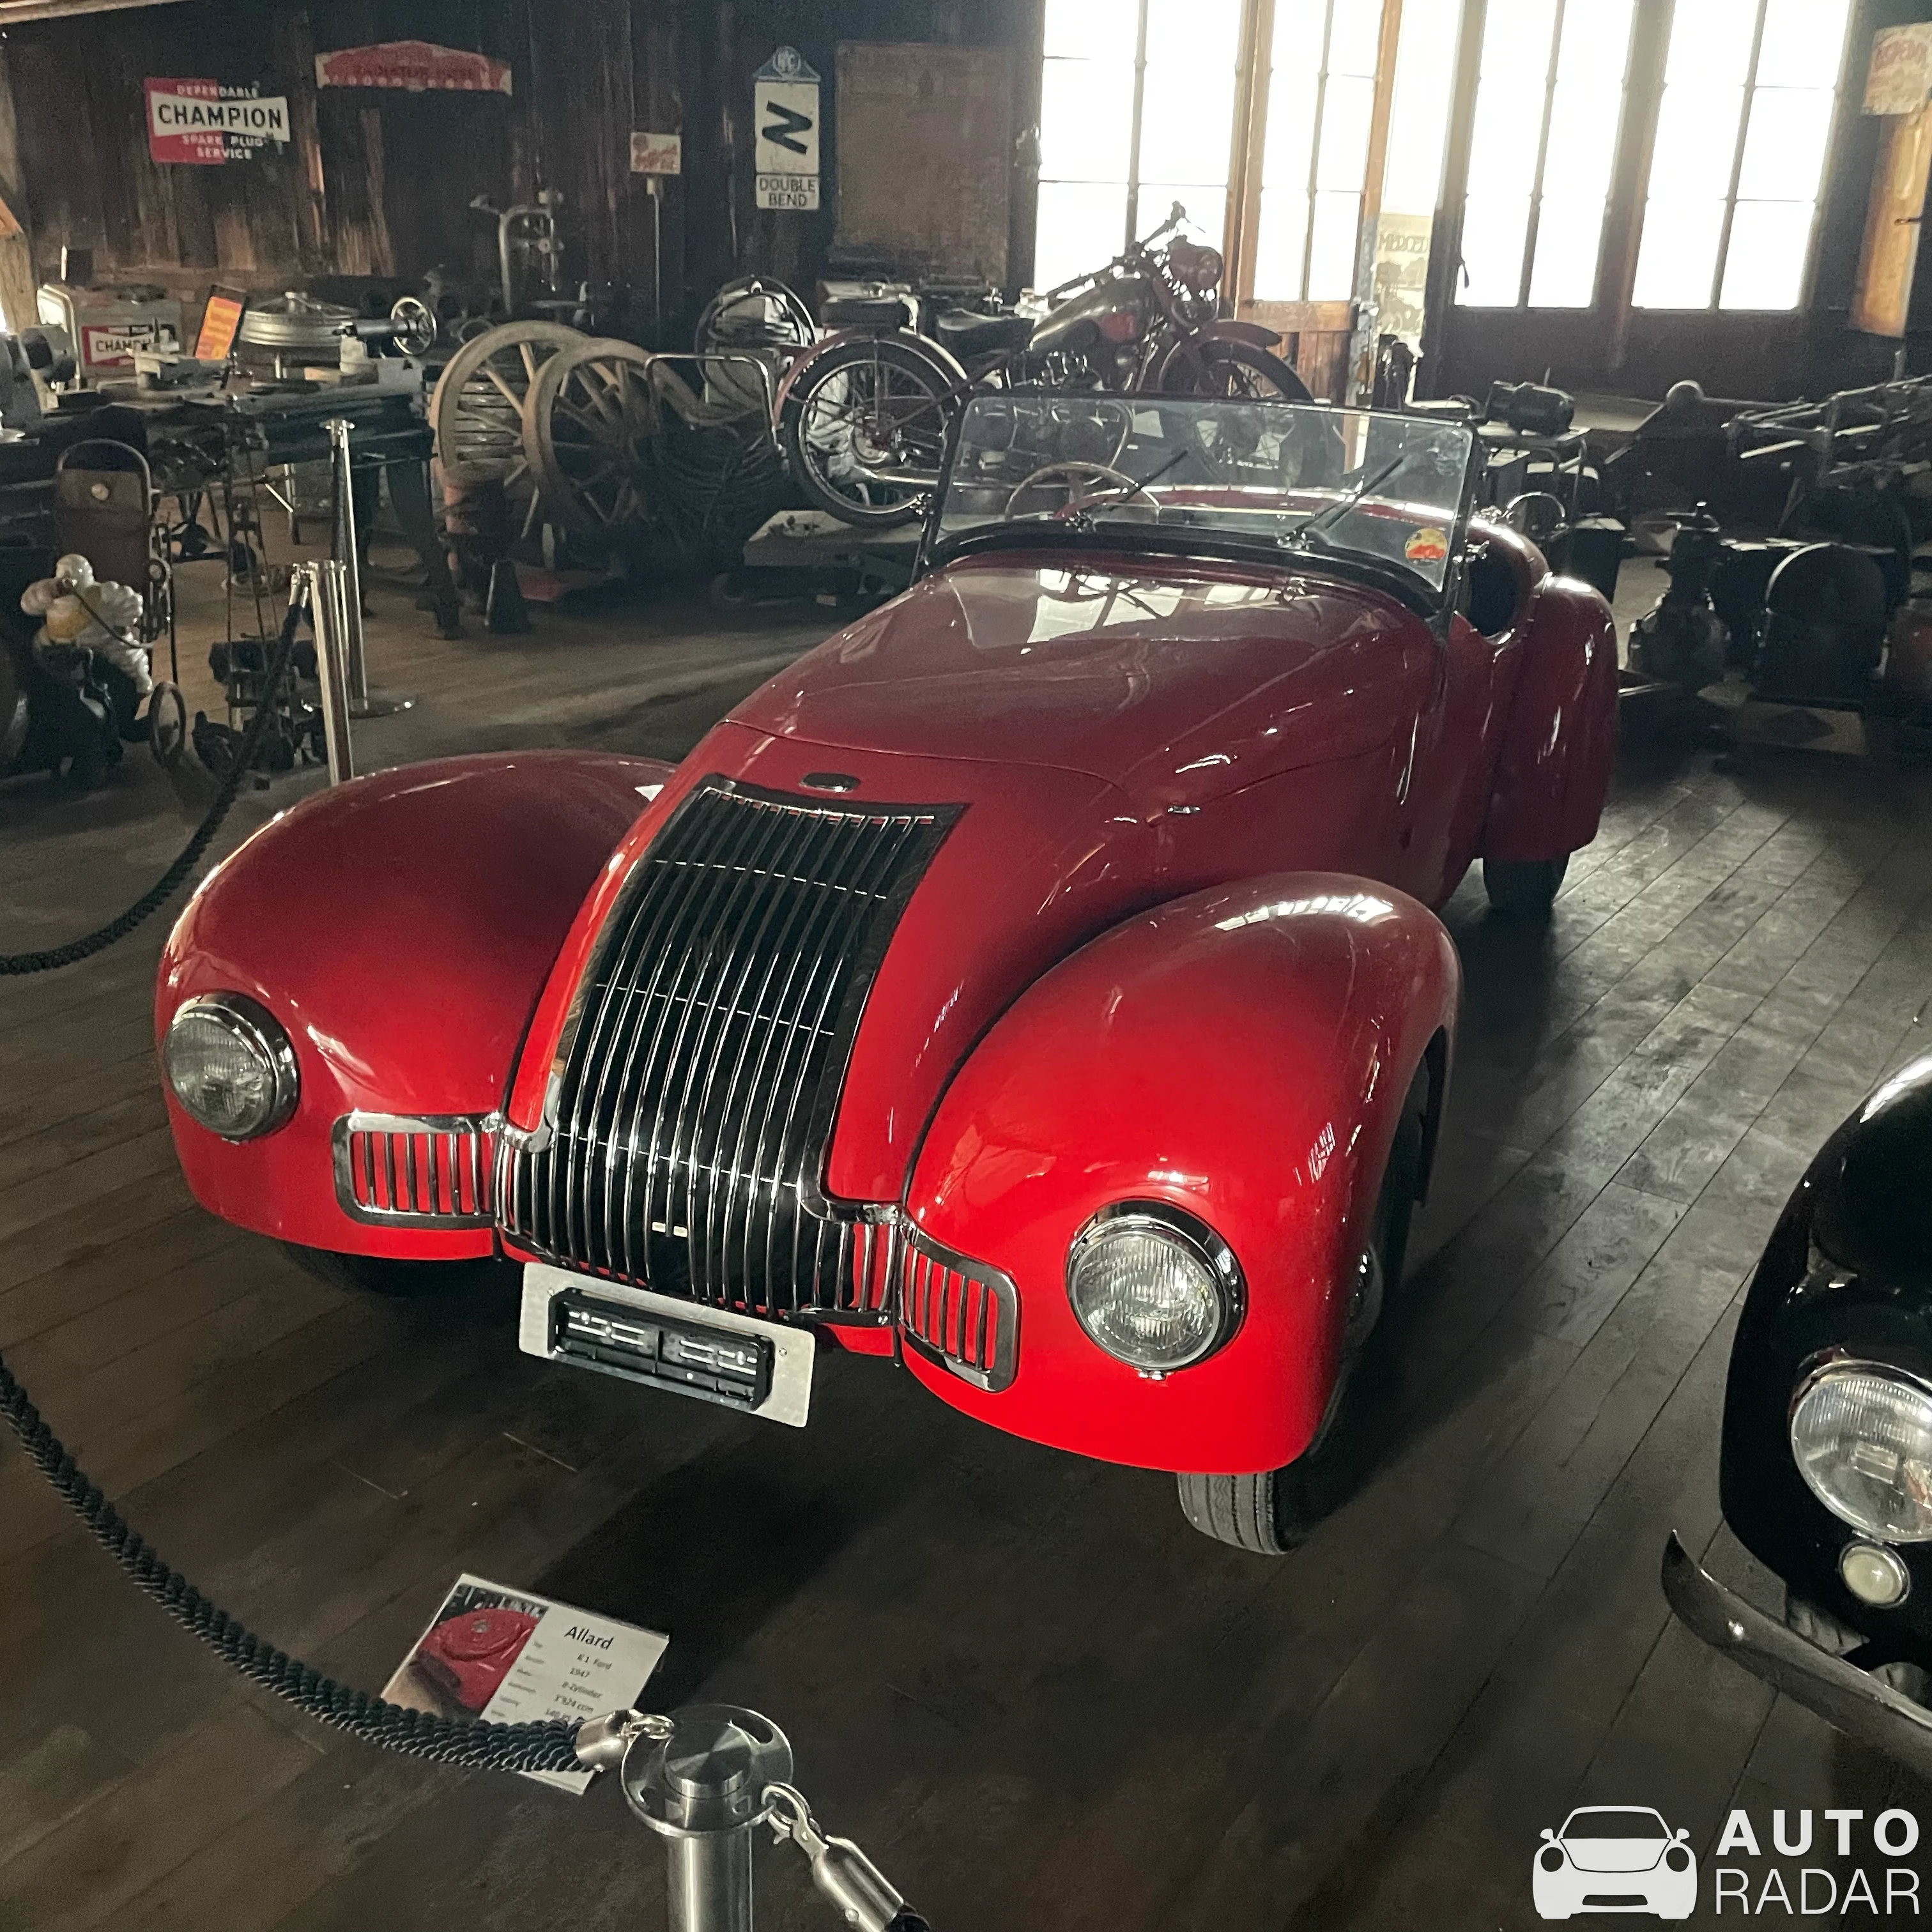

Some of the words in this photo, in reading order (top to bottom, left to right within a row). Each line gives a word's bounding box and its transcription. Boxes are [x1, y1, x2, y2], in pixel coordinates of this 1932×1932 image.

[158, 104, 282, 129] CHAMPION
[182, 135, 222, 146] SPARK
[231, 135, 264, 147] PLUG
[197, 146, 252, 160] SERVICE
[759, 177, 816, 193] DOUBLE
[769, 194, 807, 208] BEND
[564, 1626, 614, 1650] Allard
